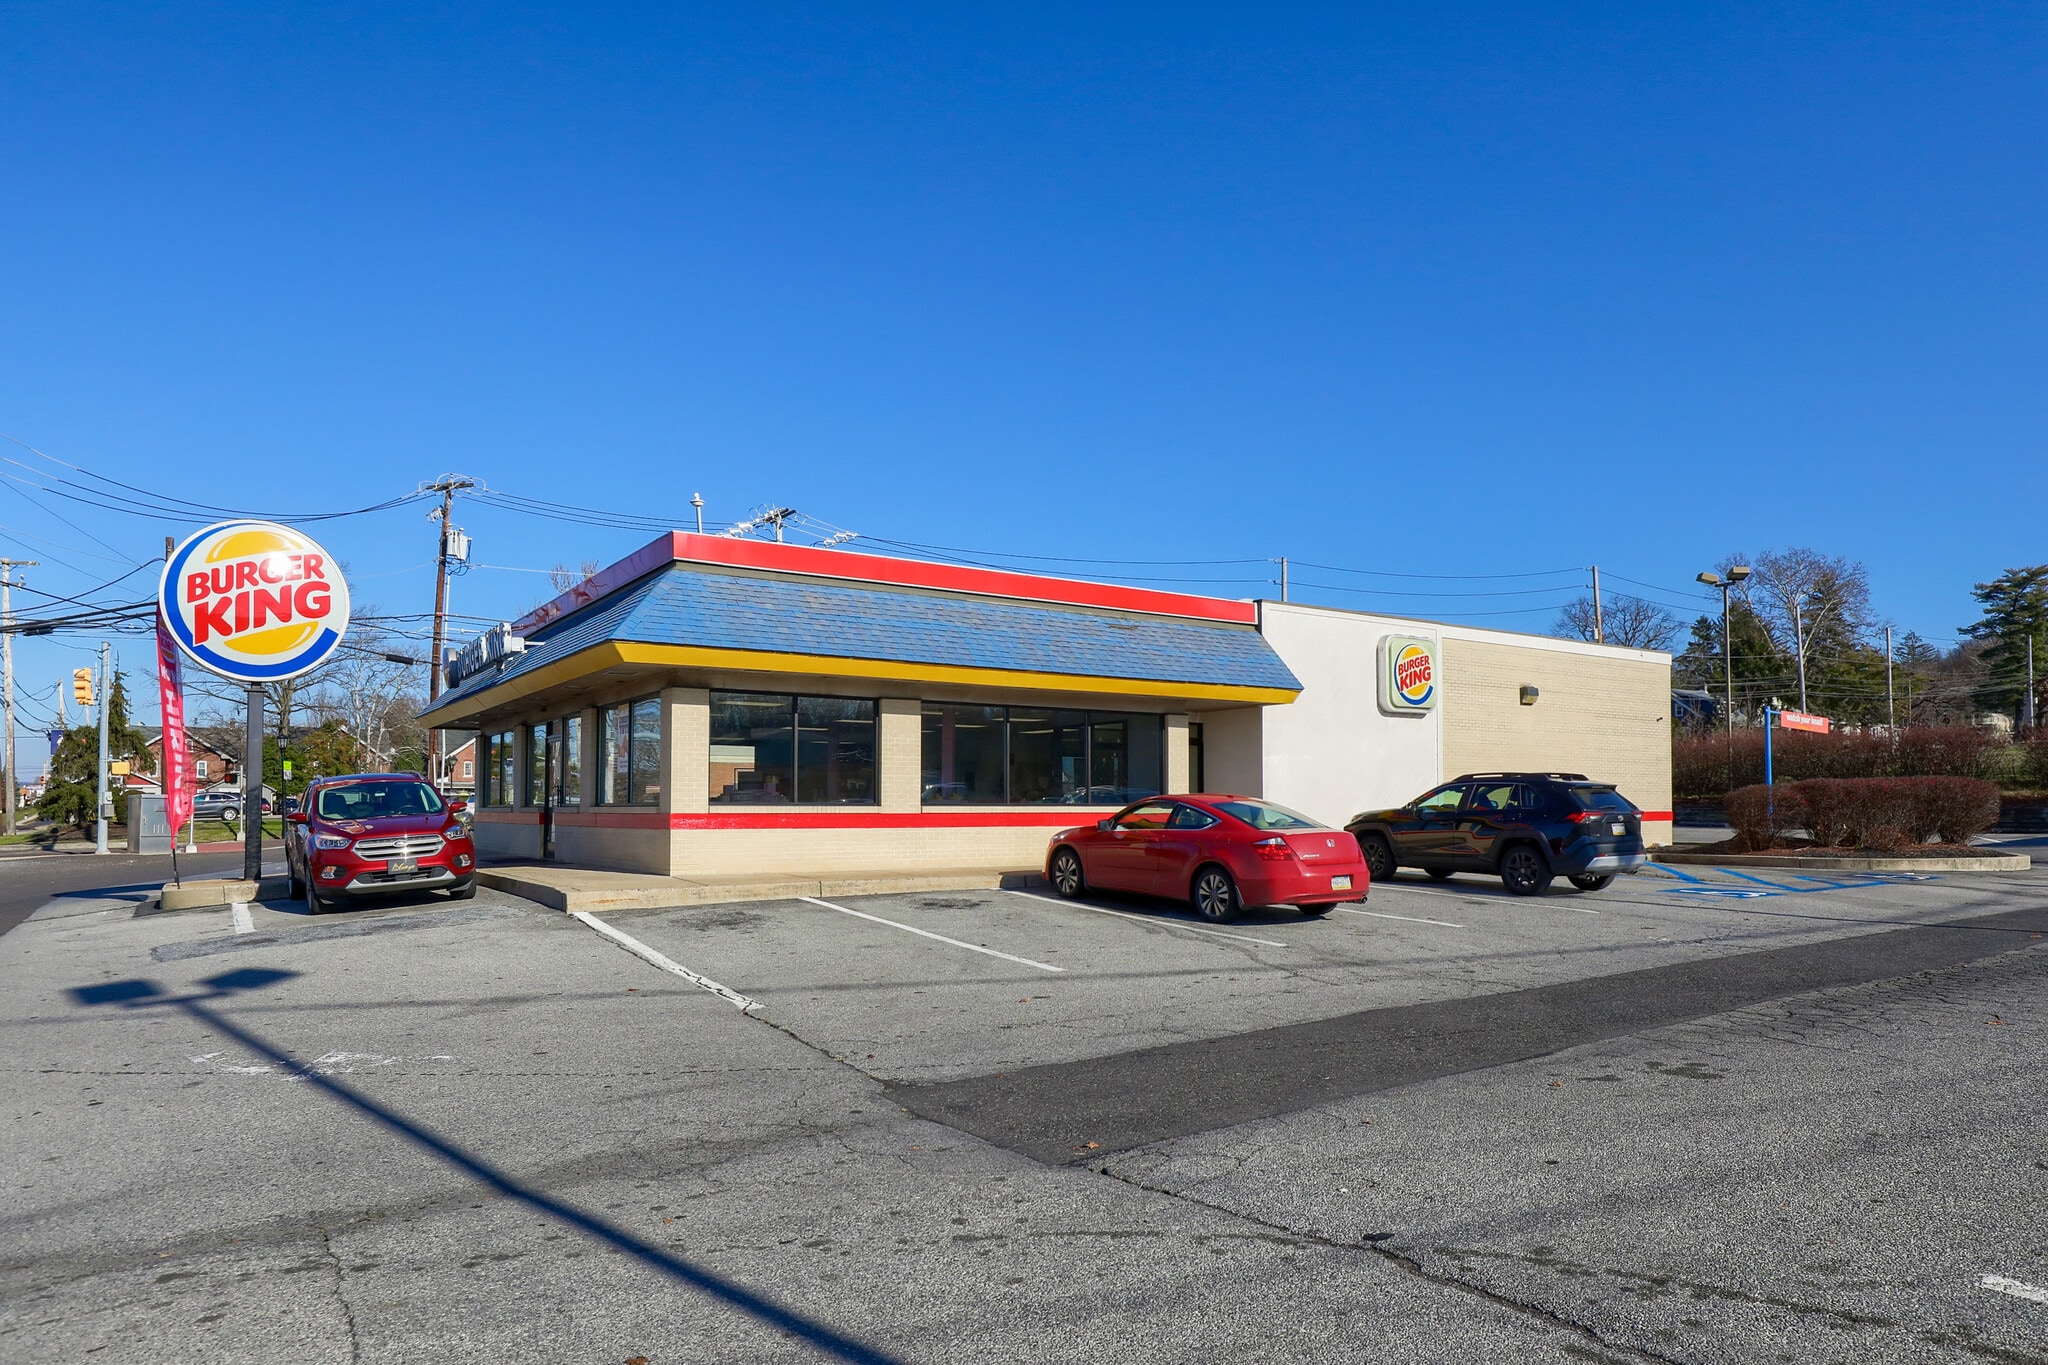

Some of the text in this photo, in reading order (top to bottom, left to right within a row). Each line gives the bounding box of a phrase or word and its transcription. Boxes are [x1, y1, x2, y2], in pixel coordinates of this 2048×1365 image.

[187, 554, 325, 603] BURGER
[194, 581, 331, 645] KING
[1398, 655, 1430, 676] BURGER
[1400, 666, 1431, 691] KING
